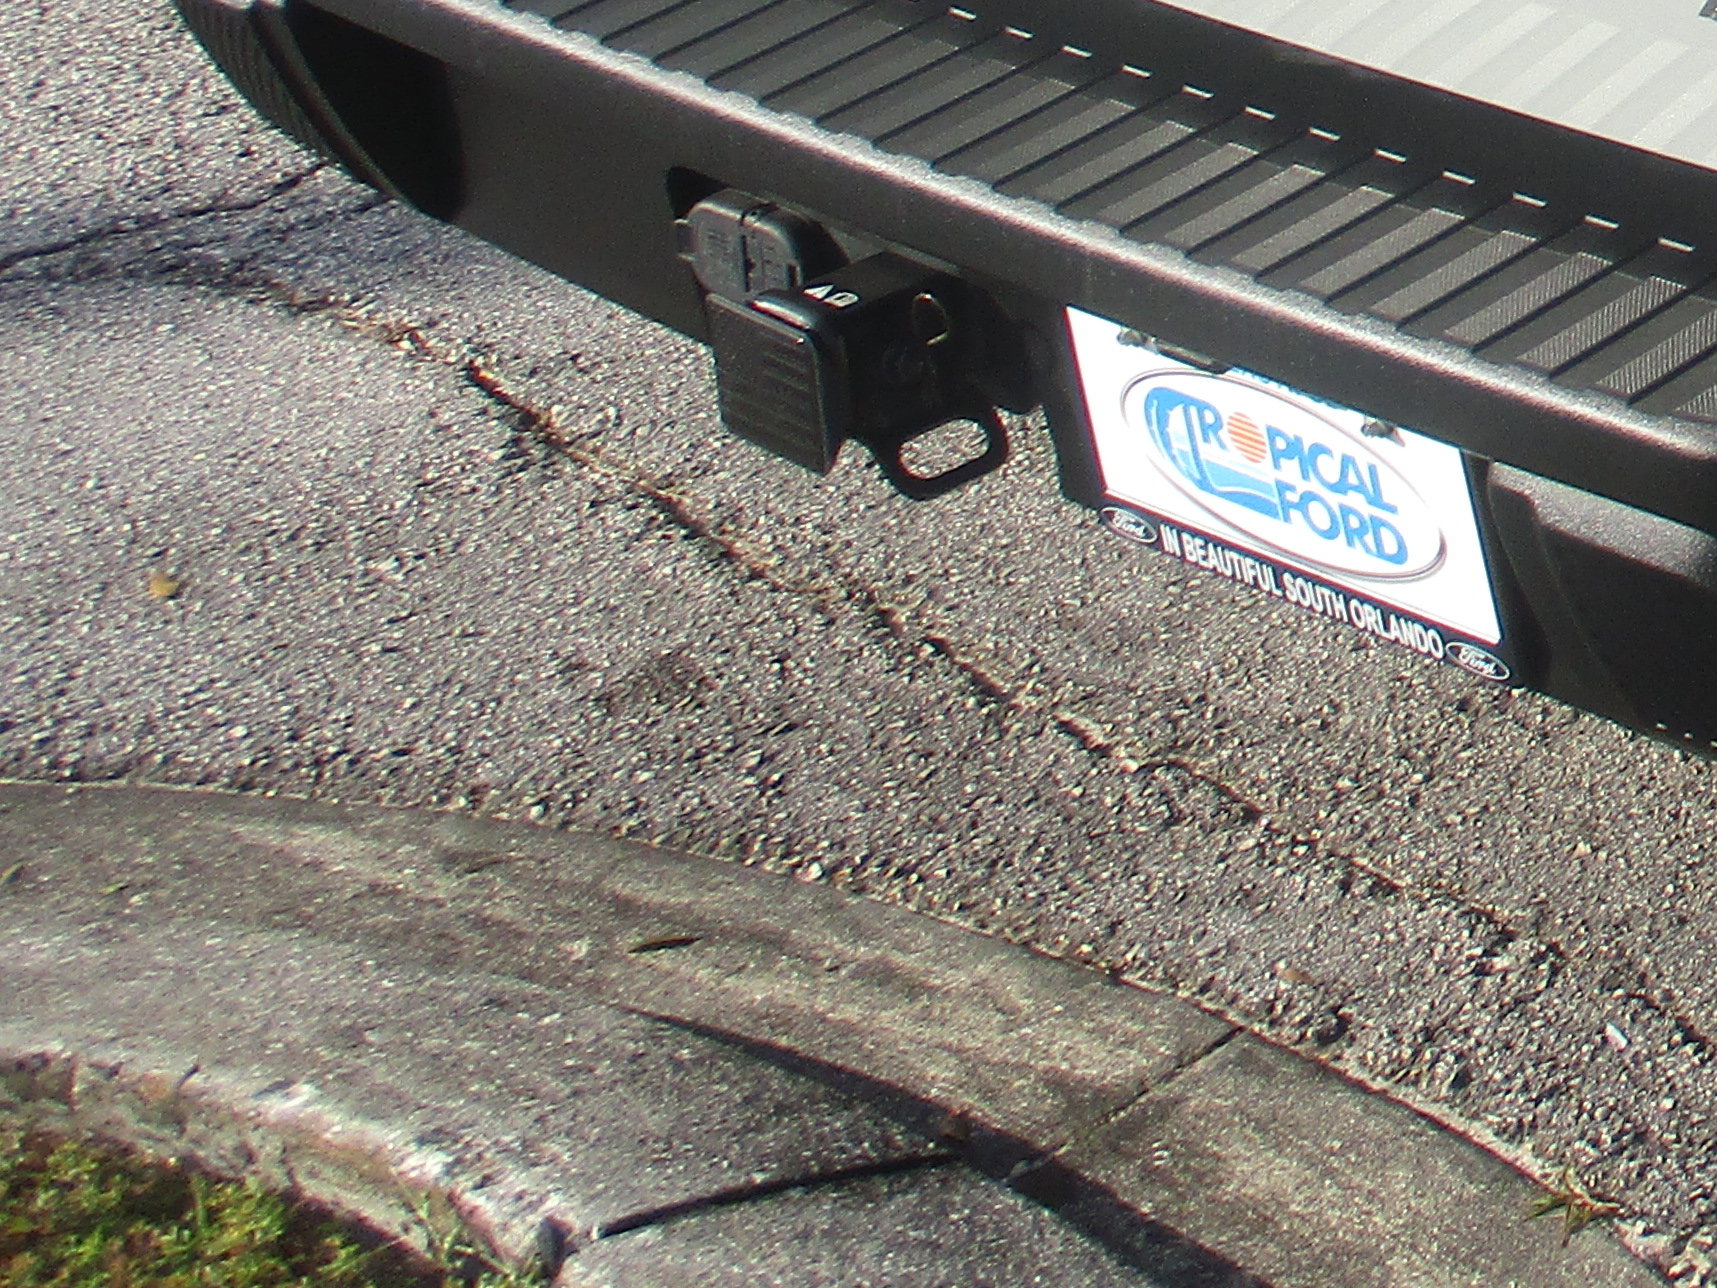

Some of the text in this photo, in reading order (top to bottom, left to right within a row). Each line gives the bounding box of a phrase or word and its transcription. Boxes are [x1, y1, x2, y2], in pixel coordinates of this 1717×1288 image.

[1275, 477, 1408, 566] FORD
[1159, 522, 1444, 661] IN BEAUTIFUL SOUTH ORLANDO
